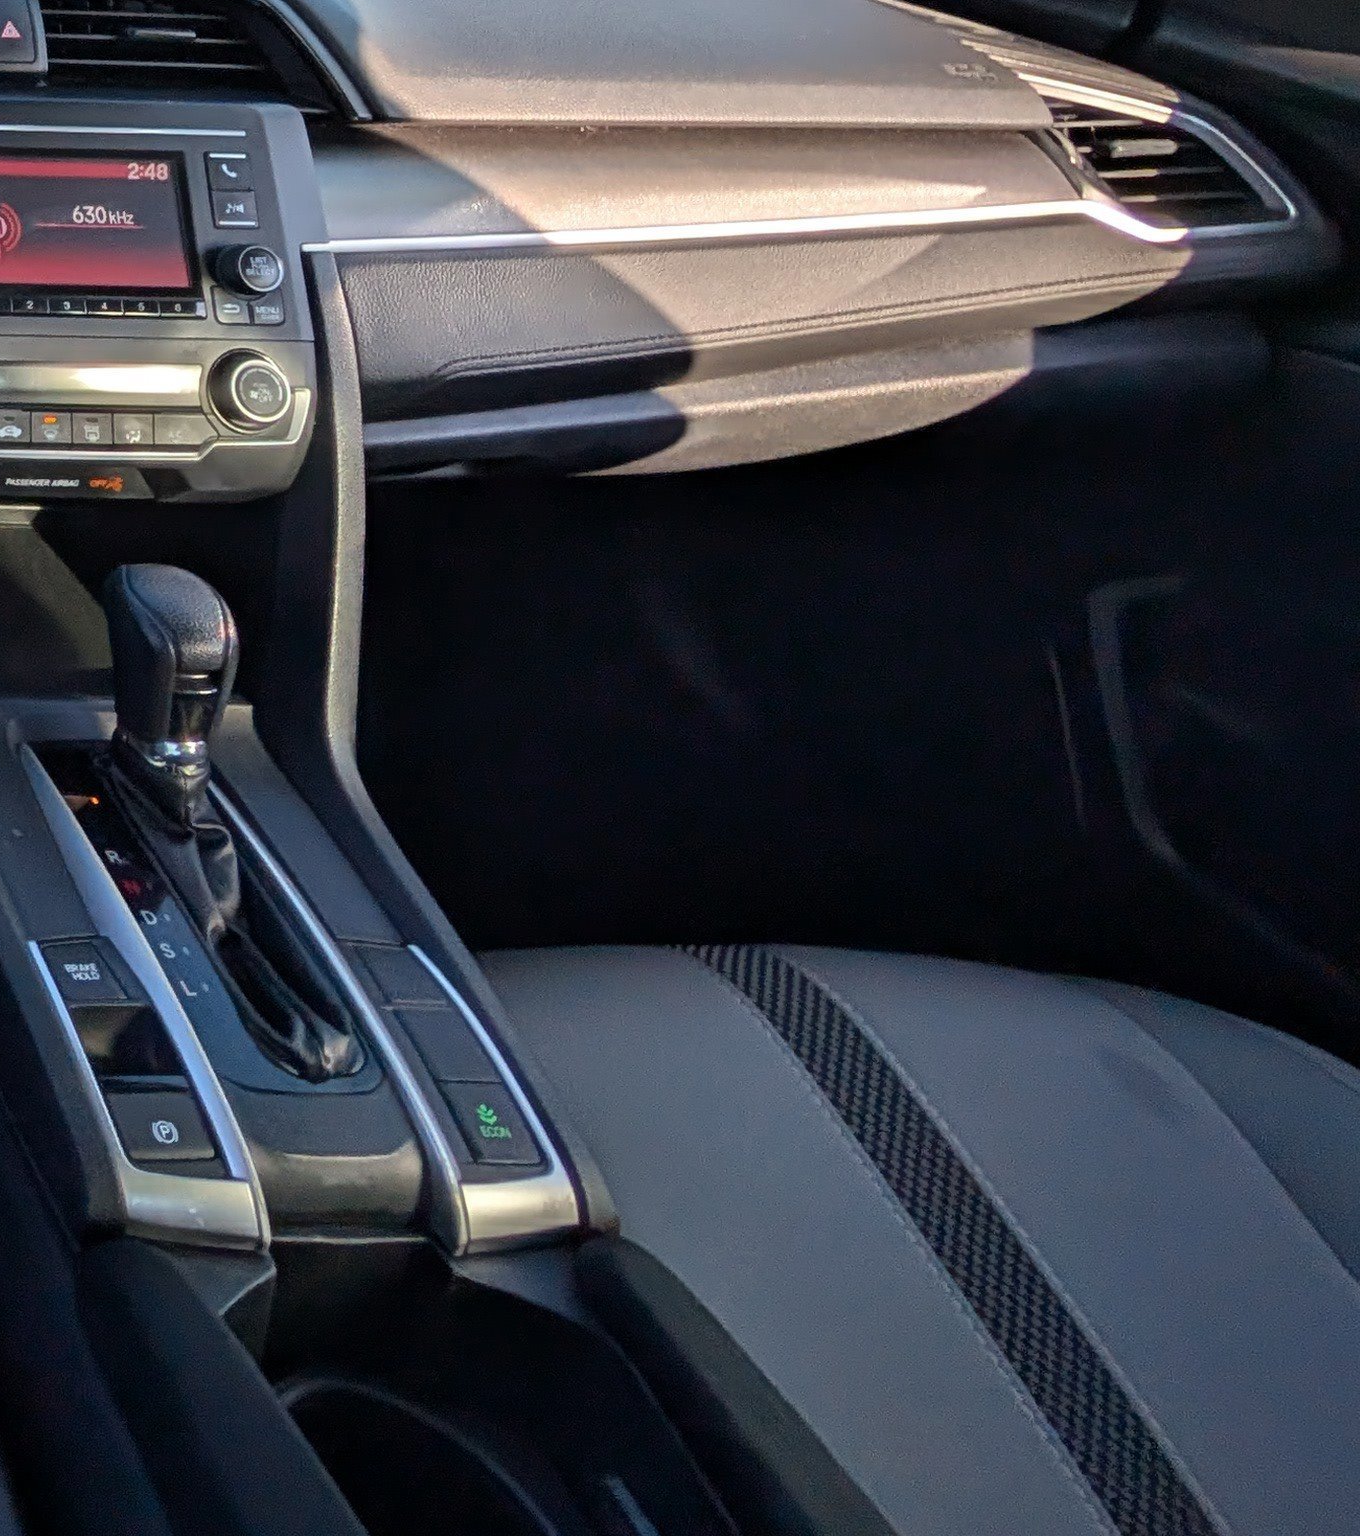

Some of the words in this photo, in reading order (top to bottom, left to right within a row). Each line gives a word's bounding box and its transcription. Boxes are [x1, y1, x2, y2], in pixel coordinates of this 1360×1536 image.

[126, 162, 169, 181] 2:48
[105, 850, 118, 863] R
[140, 910, 157, 926] D
[159, 943, 176, 959] S
[64, 963, 98, 974] BRAKE
[70, 971, 100, 981] HOLD
[180, 980, 197, 997] L
[480, 1125, 513, 1139] ECON
